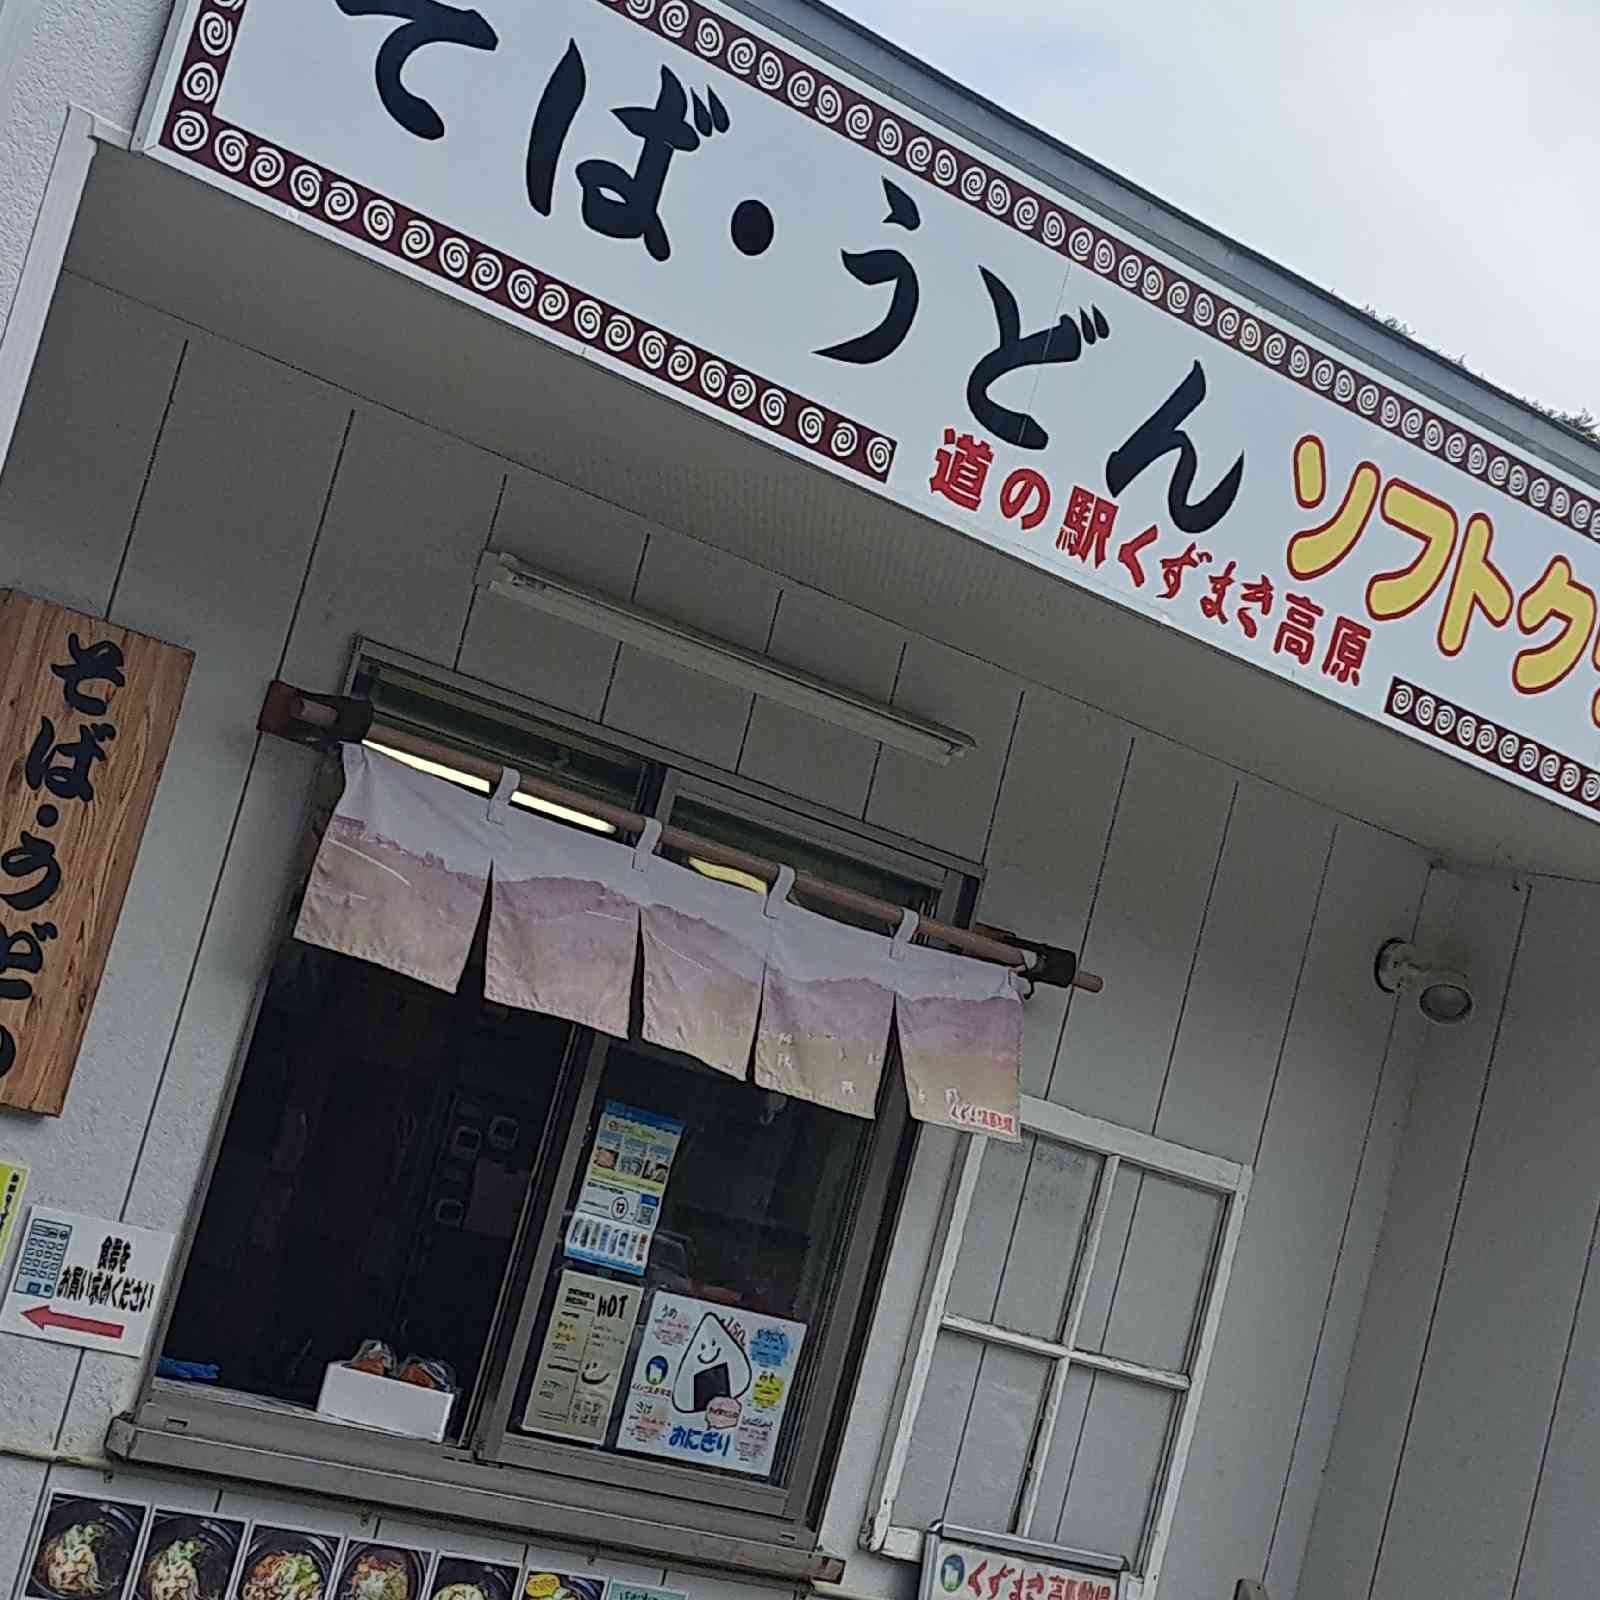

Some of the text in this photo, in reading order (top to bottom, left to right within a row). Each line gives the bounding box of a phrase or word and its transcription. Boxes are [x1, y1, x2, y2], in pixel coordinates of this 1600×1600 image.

[928, 428, 1372, 687] 道の駅くずまき高原
[1287, 432, 1600, 729] ソフトク
[598, 1293, 629, 1319] HOT
[669, 1424, 732, 1457] おにぎり
